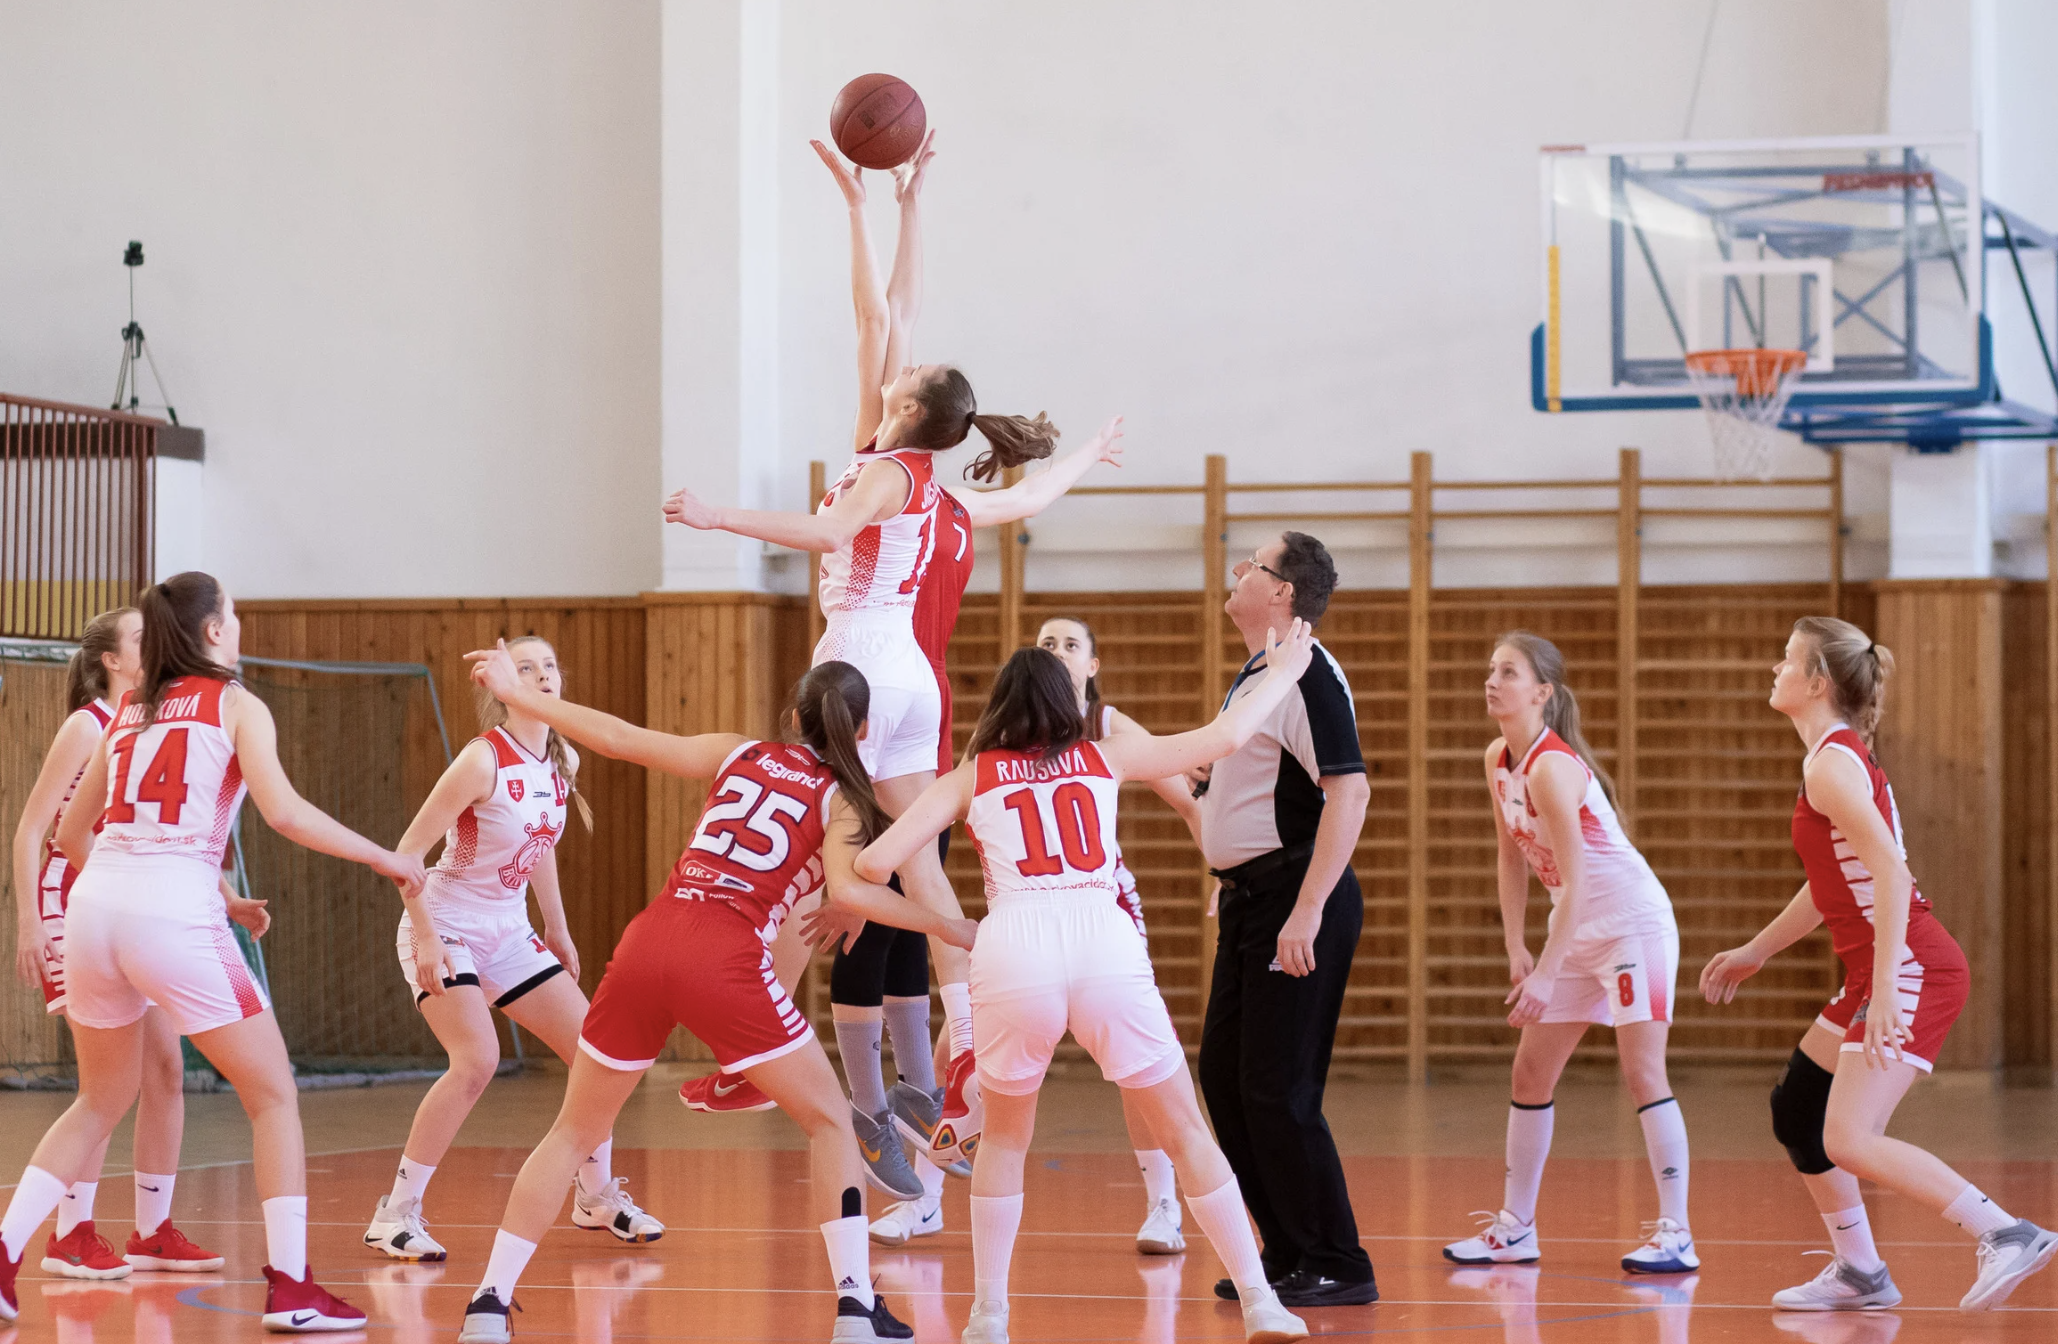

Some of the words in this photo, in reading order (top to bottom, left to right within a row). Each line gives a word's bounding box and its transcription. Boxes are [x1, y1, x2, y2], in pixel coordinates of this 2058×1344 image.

[103, 728, 189, 825] 14
[756, 753, 825, 790] legrand
[688, 774, 810, 872] 25
[1003, 782, 1107, 877] 10
[1618, 973, 1634, 1007] 8
